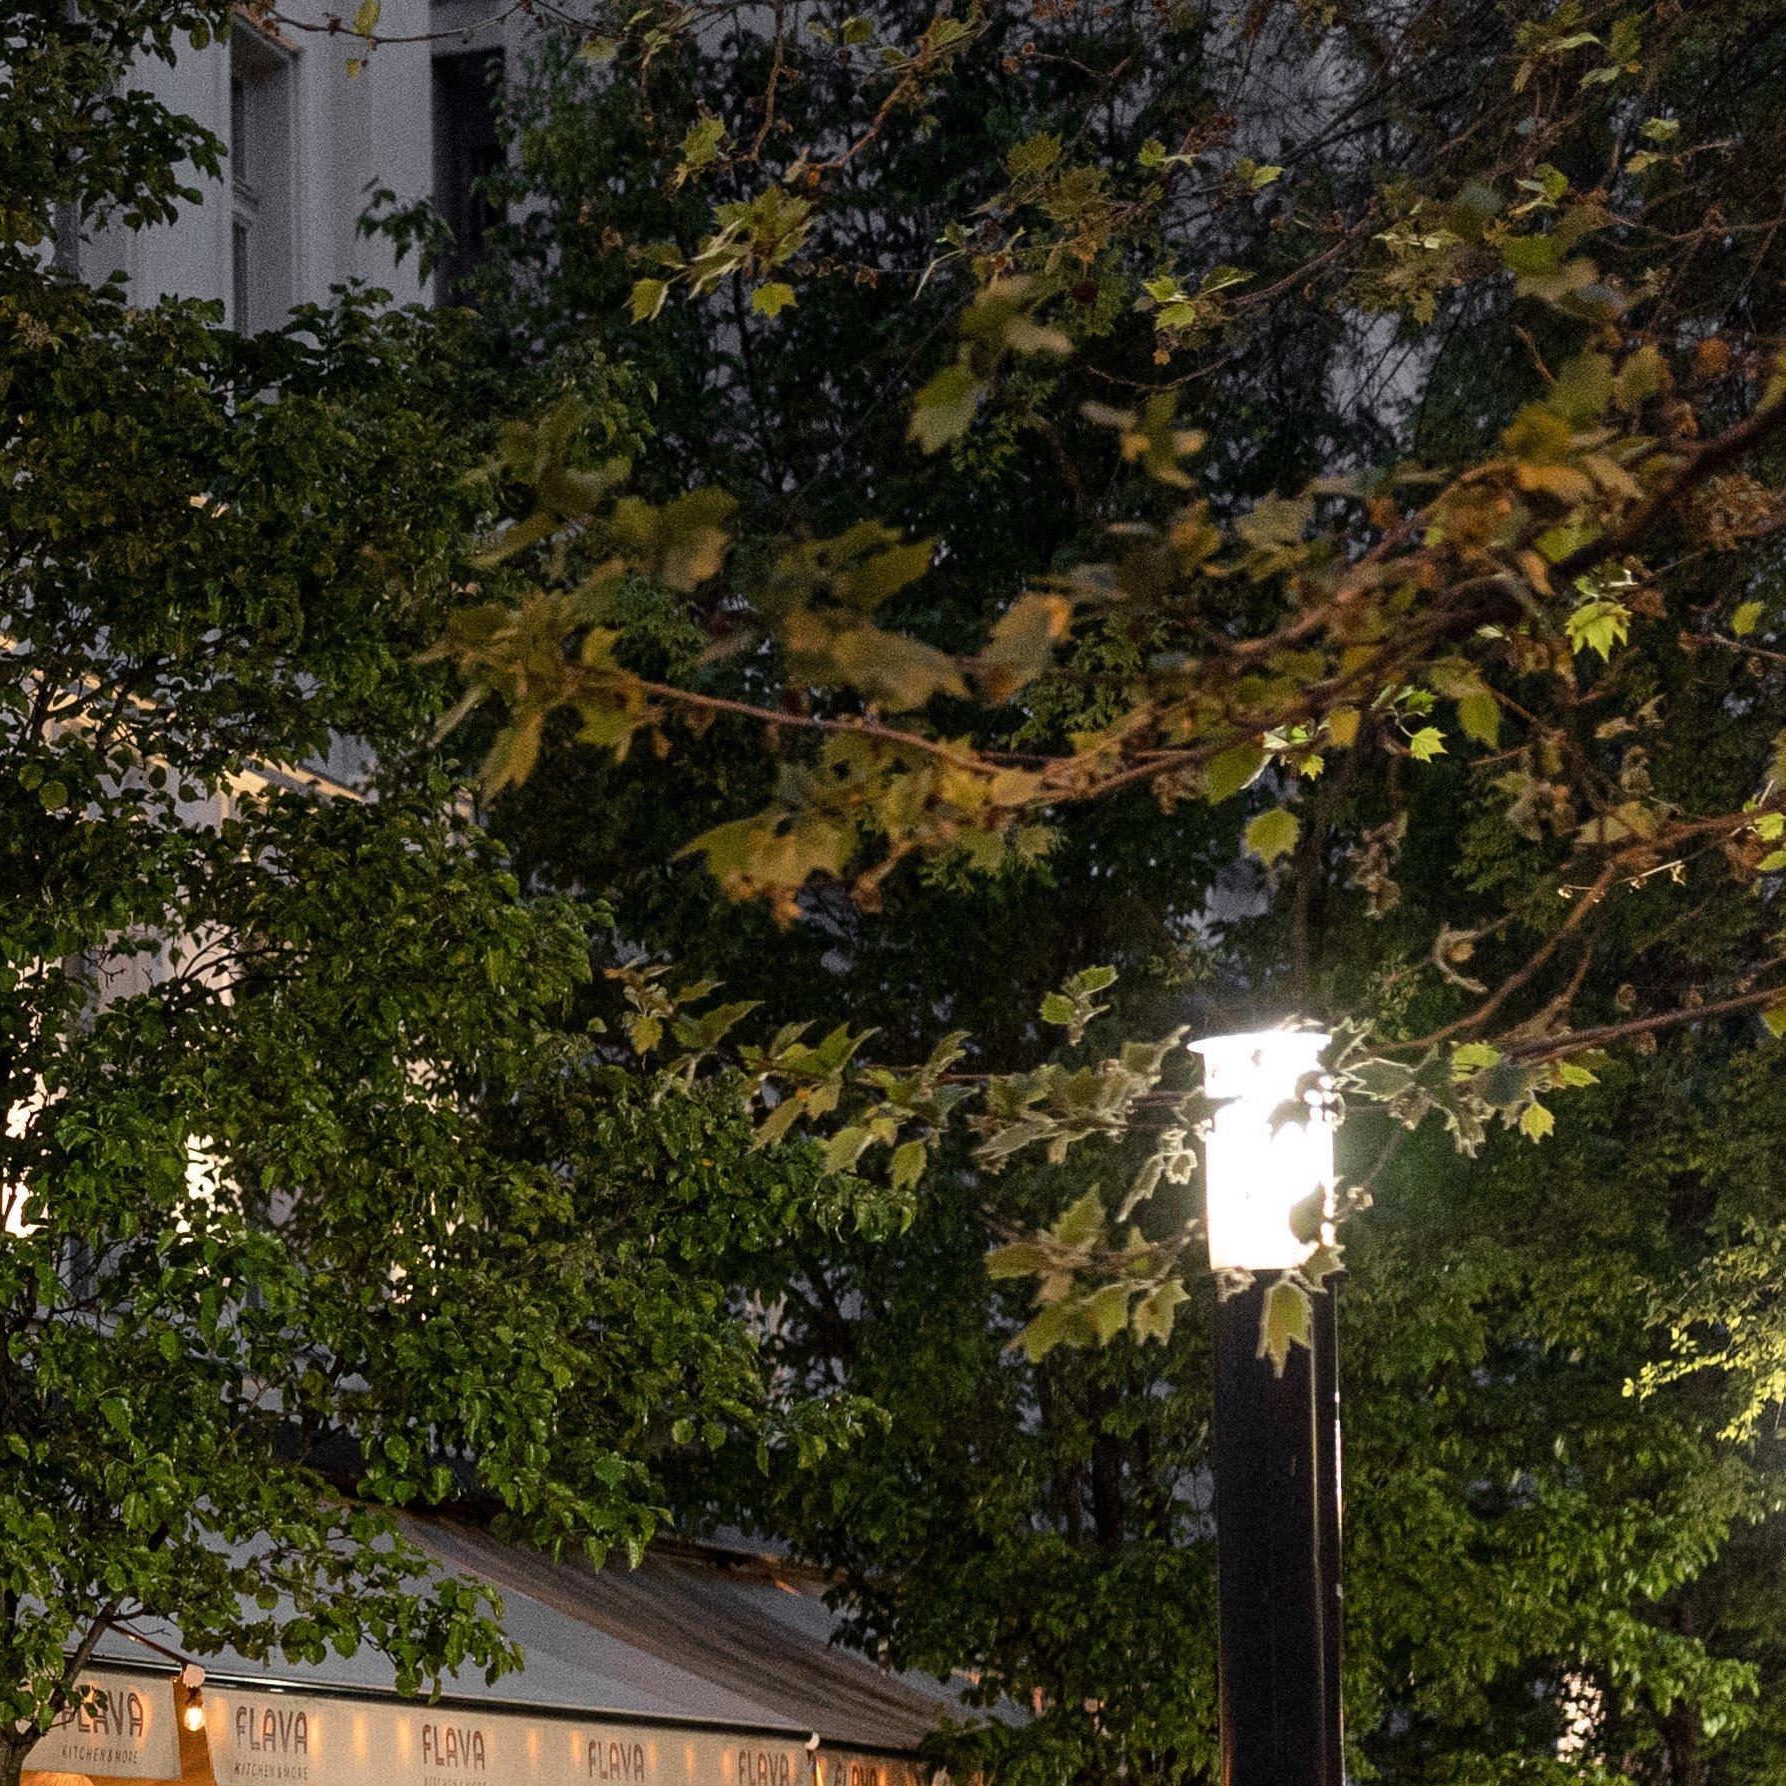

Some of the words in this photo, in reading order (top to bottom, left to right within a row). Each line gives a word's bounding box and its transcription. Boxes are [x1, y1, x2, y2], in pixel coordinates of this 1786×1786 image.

[235, 1706, 308, 1754] FLAVA
[422, 1724, 486, 1771] FLAVA
[588, 1739, 645, 1782] FLAVA
